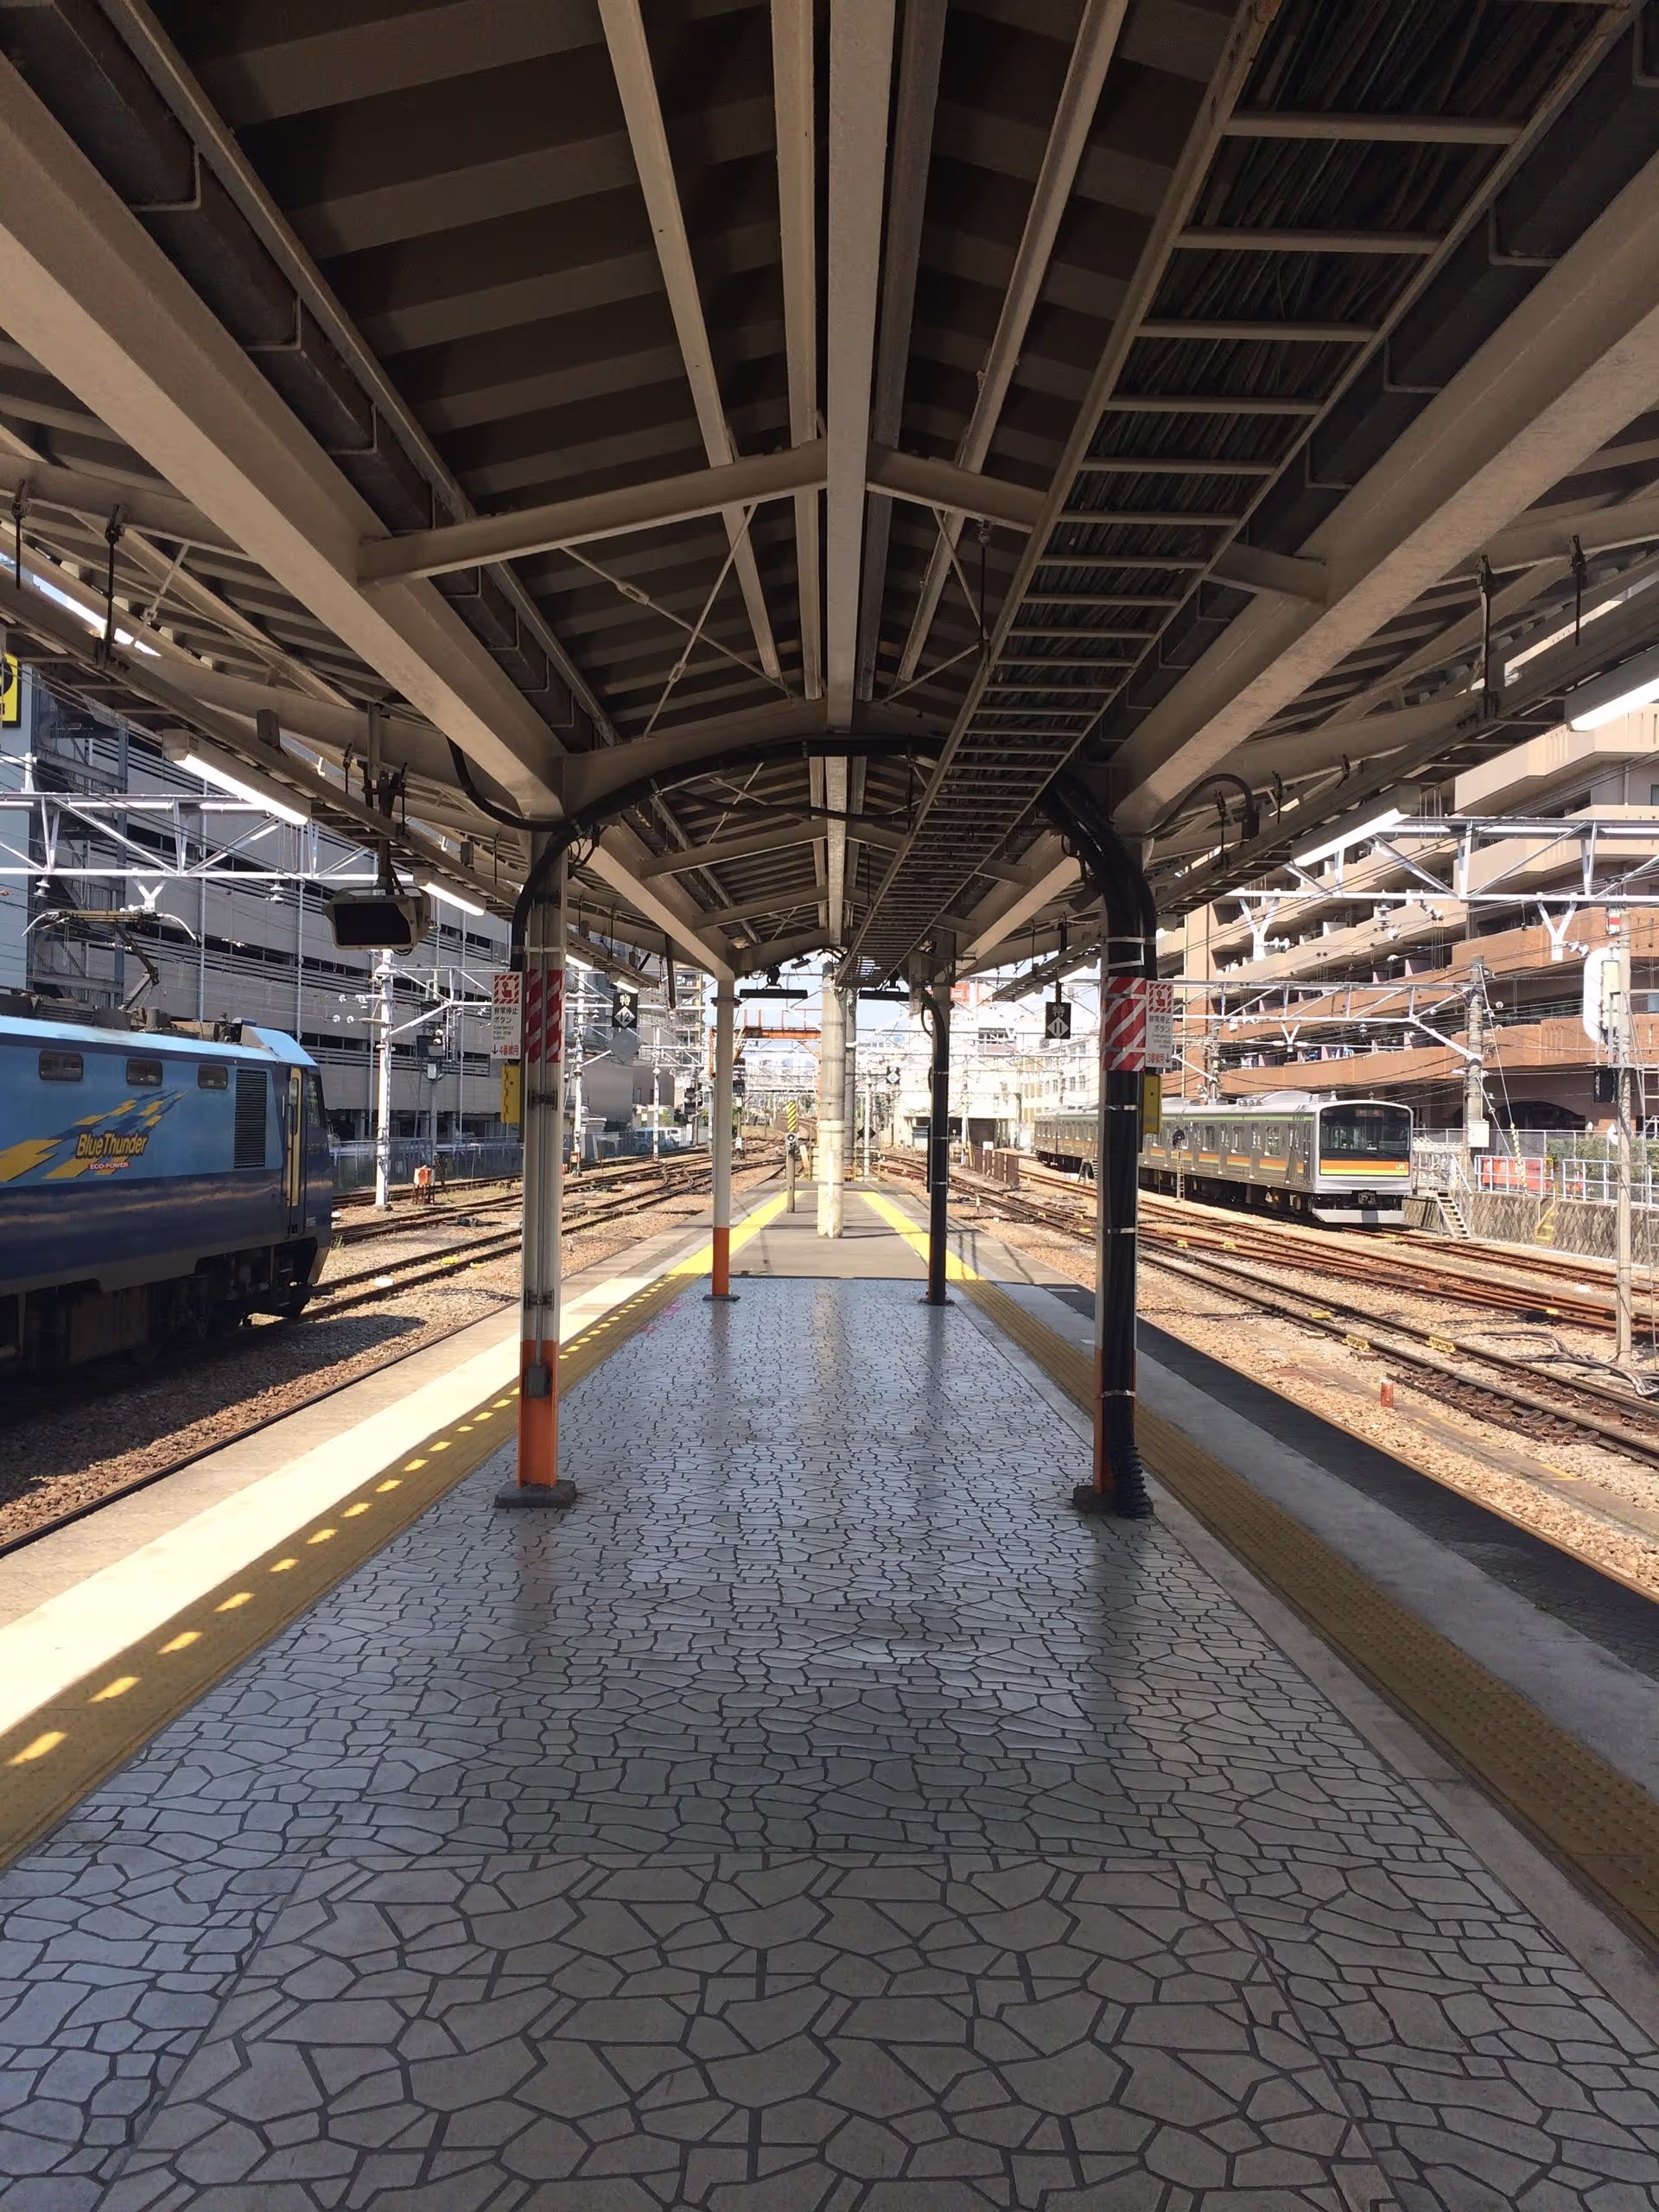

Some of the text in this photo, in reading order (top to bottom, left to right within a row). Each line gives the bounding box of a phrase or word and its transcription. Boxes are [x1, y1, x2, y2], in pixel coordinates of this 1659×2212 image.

[620, 994, 631, 1007] 特
[494, 1007, 518, 1015] 非常停止
[620, 1012, 631, 1023] 12
[1054, 1021, 1063, 1034] 11
[76, 1133, 149, 1157] Blue Thunder
